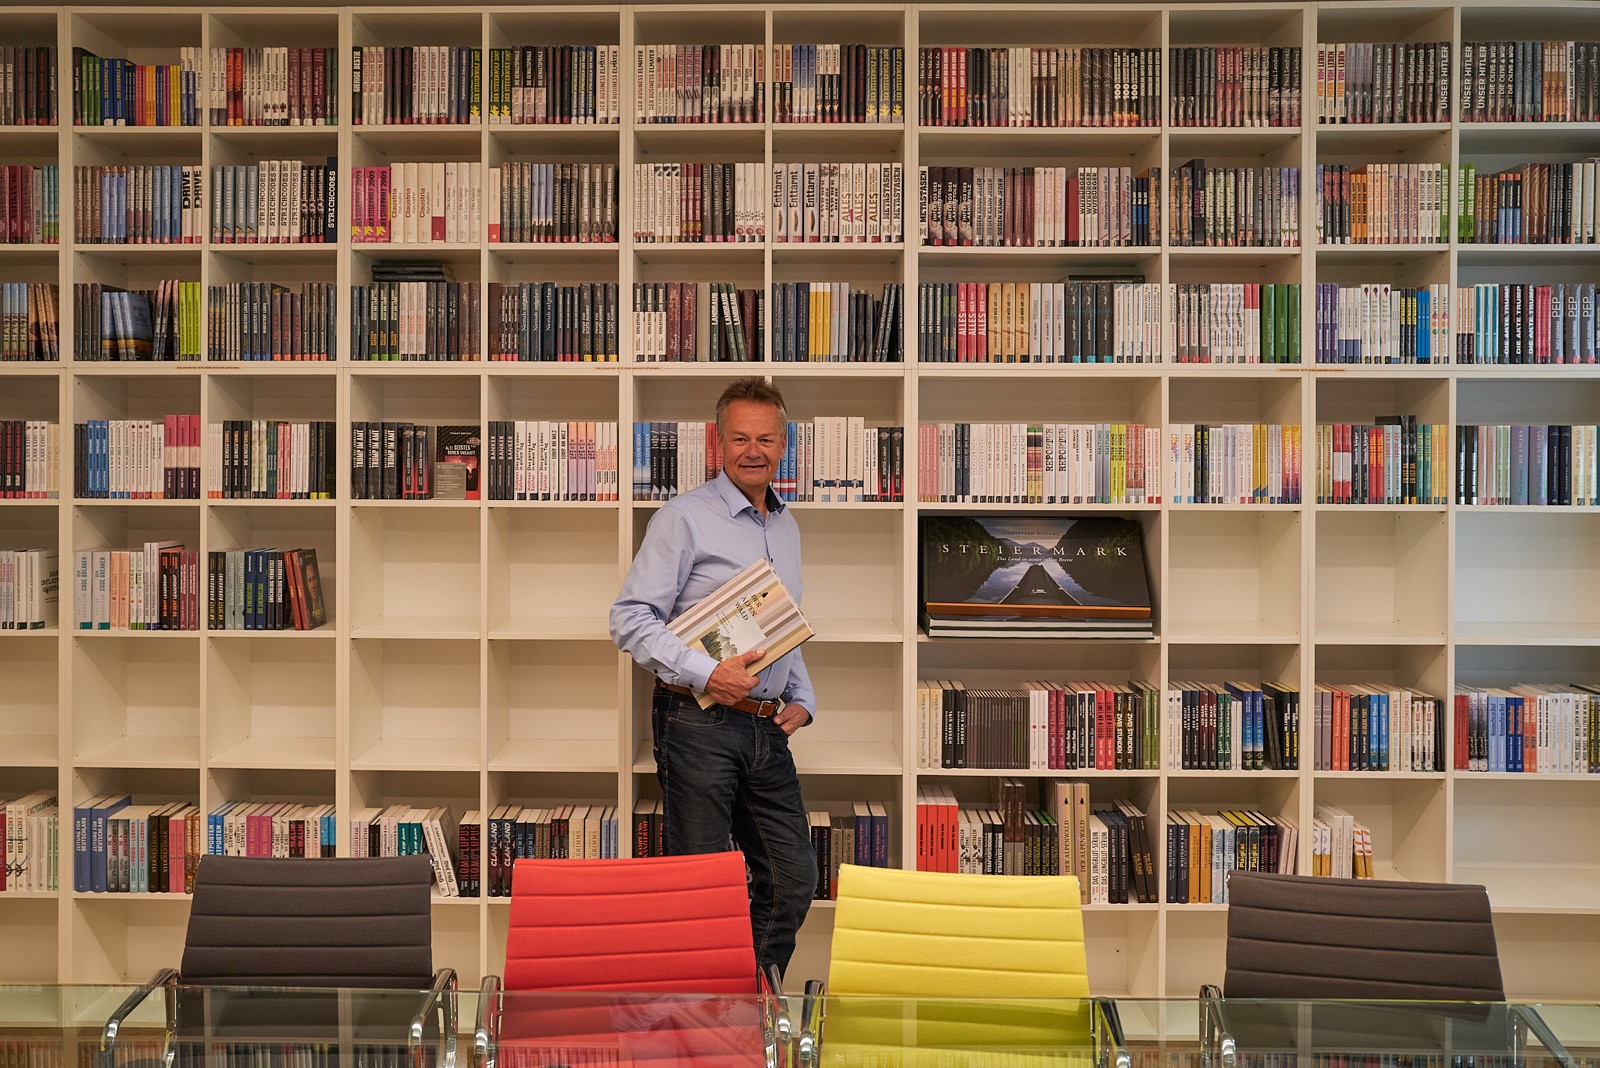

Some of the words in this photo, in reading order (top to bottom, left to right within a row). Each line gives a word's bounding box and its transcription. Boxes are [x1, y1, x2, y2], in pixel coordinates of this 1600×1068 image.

[1464, 46, 1472, 77] HITLER
[1478, 46, 1486, 77] HITLER
[1464, 80, 1472, 108] UNSER
[1478, 80, 1486, 108] UNSER
[194, 170, 202, 208] DRIVE
[774, 171, 782, 208] Enttarnt
[789, 171, 797, 208] Enttarnt
[806, 171, 815, 208] Enttarnt
[1552, 297, 1560, 317] PEP
[1569, 297, 1577, 317] PEP
[1583, 297, 1591, 317] PEP
[978, 314, 986, 335] ALLES
[372, 450, 380, 467] TRUMP
[942, 544, 1127, 556] STEIERMARK
[735, 602, 748, 621] WALD
[741, 597, 757, 616] ALPEN
[752, 594, 761, 607] DER
[460, 825, 469, 852] LUPUS
[470, 825, 479, 852] LUPUS
[460, 855, 469, 879] HOMO
[470, 855, 479, 879] HOMO
[1091, 874, 1099, 885] DAS
